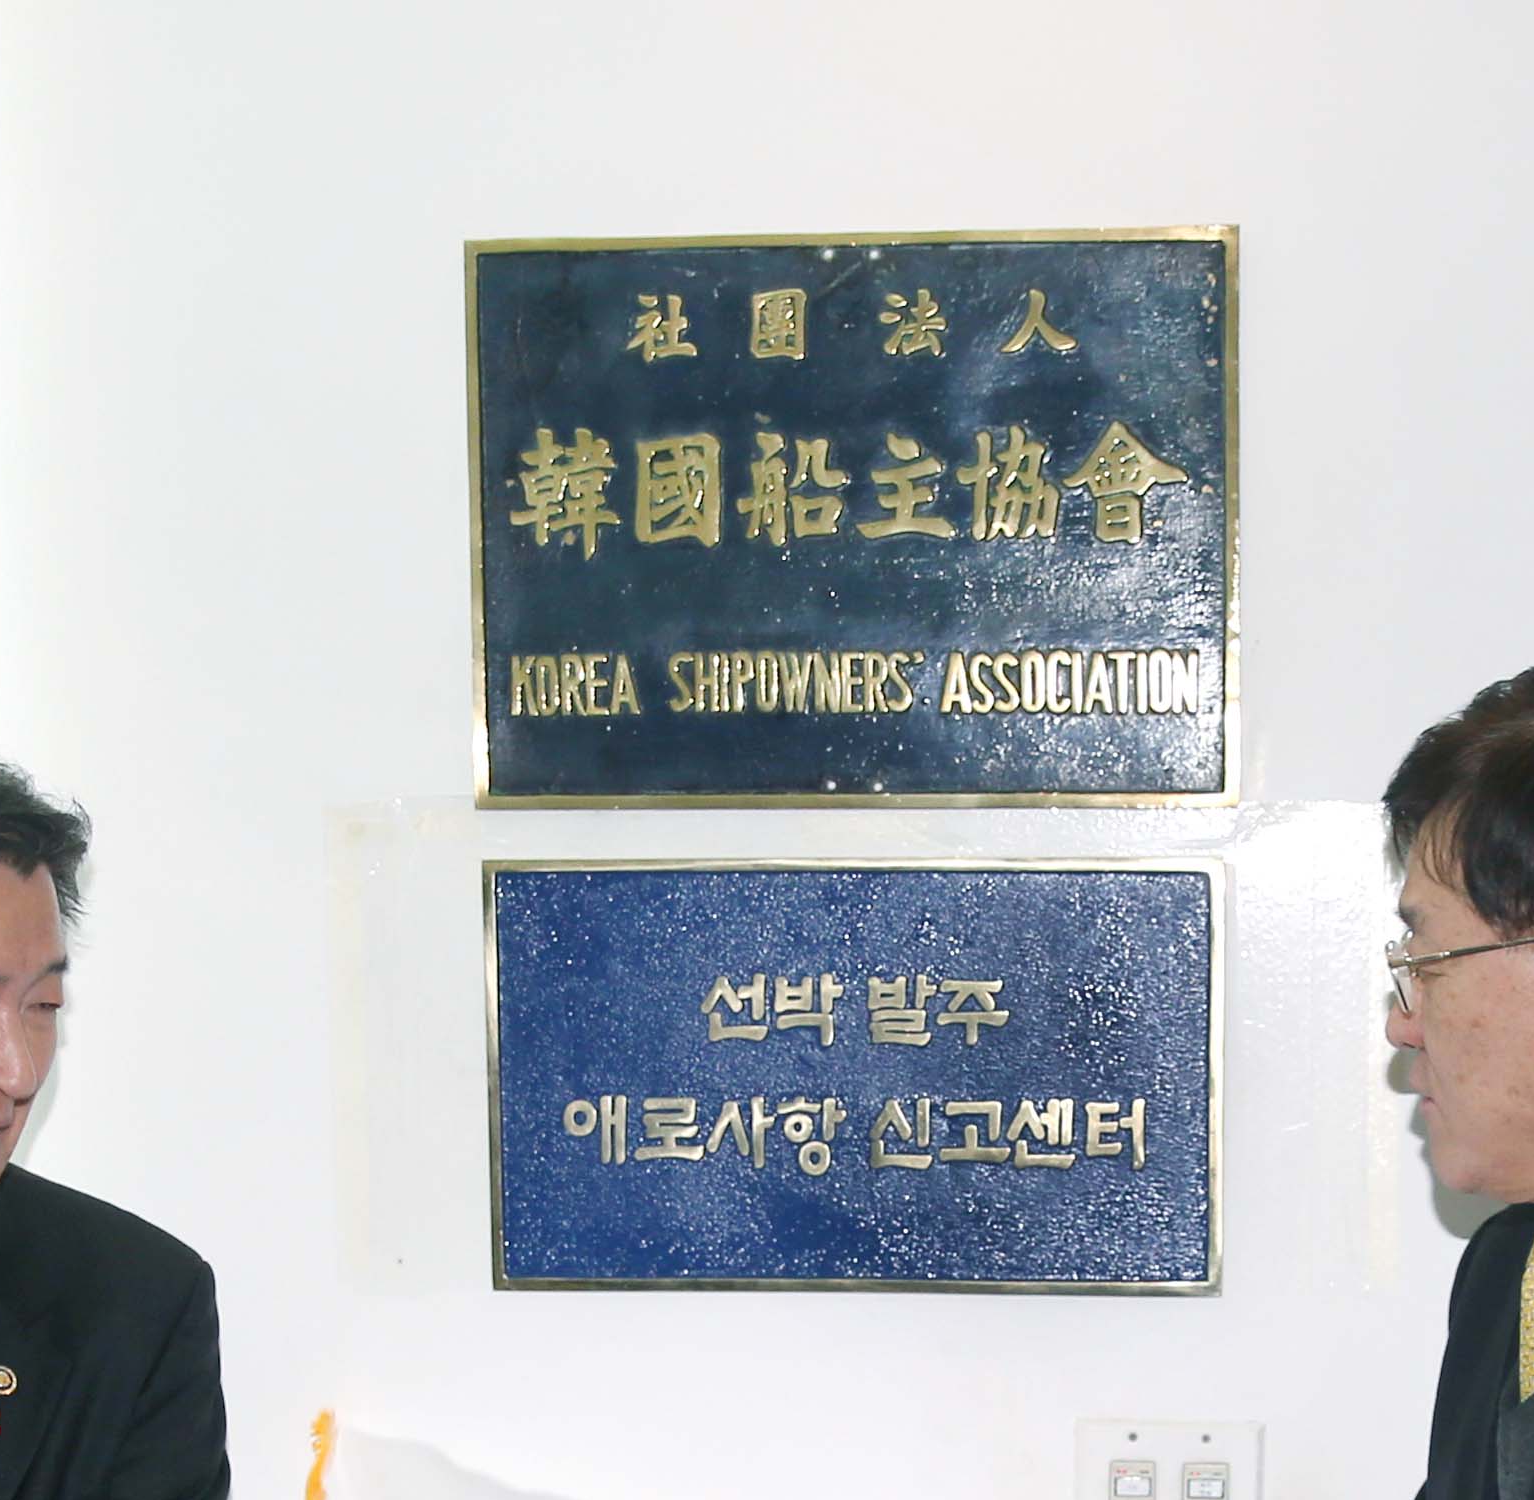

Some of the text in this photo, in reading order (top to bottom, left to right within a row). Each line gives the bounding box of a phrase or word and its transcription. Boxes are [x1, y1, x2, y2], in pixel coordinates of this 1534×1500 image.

[626, 288, 1078, 362] 社團法人
[509, 421, 1188, 561] 韓國船主協會
[510, 653, 641, 718] KOREA
[940, 649, 1200, 715] ASSOCIATION
[701, 972, 1011, 1047] 선박 발주
[563, 1095, 1147, 1176] 애로사항 신고센터
